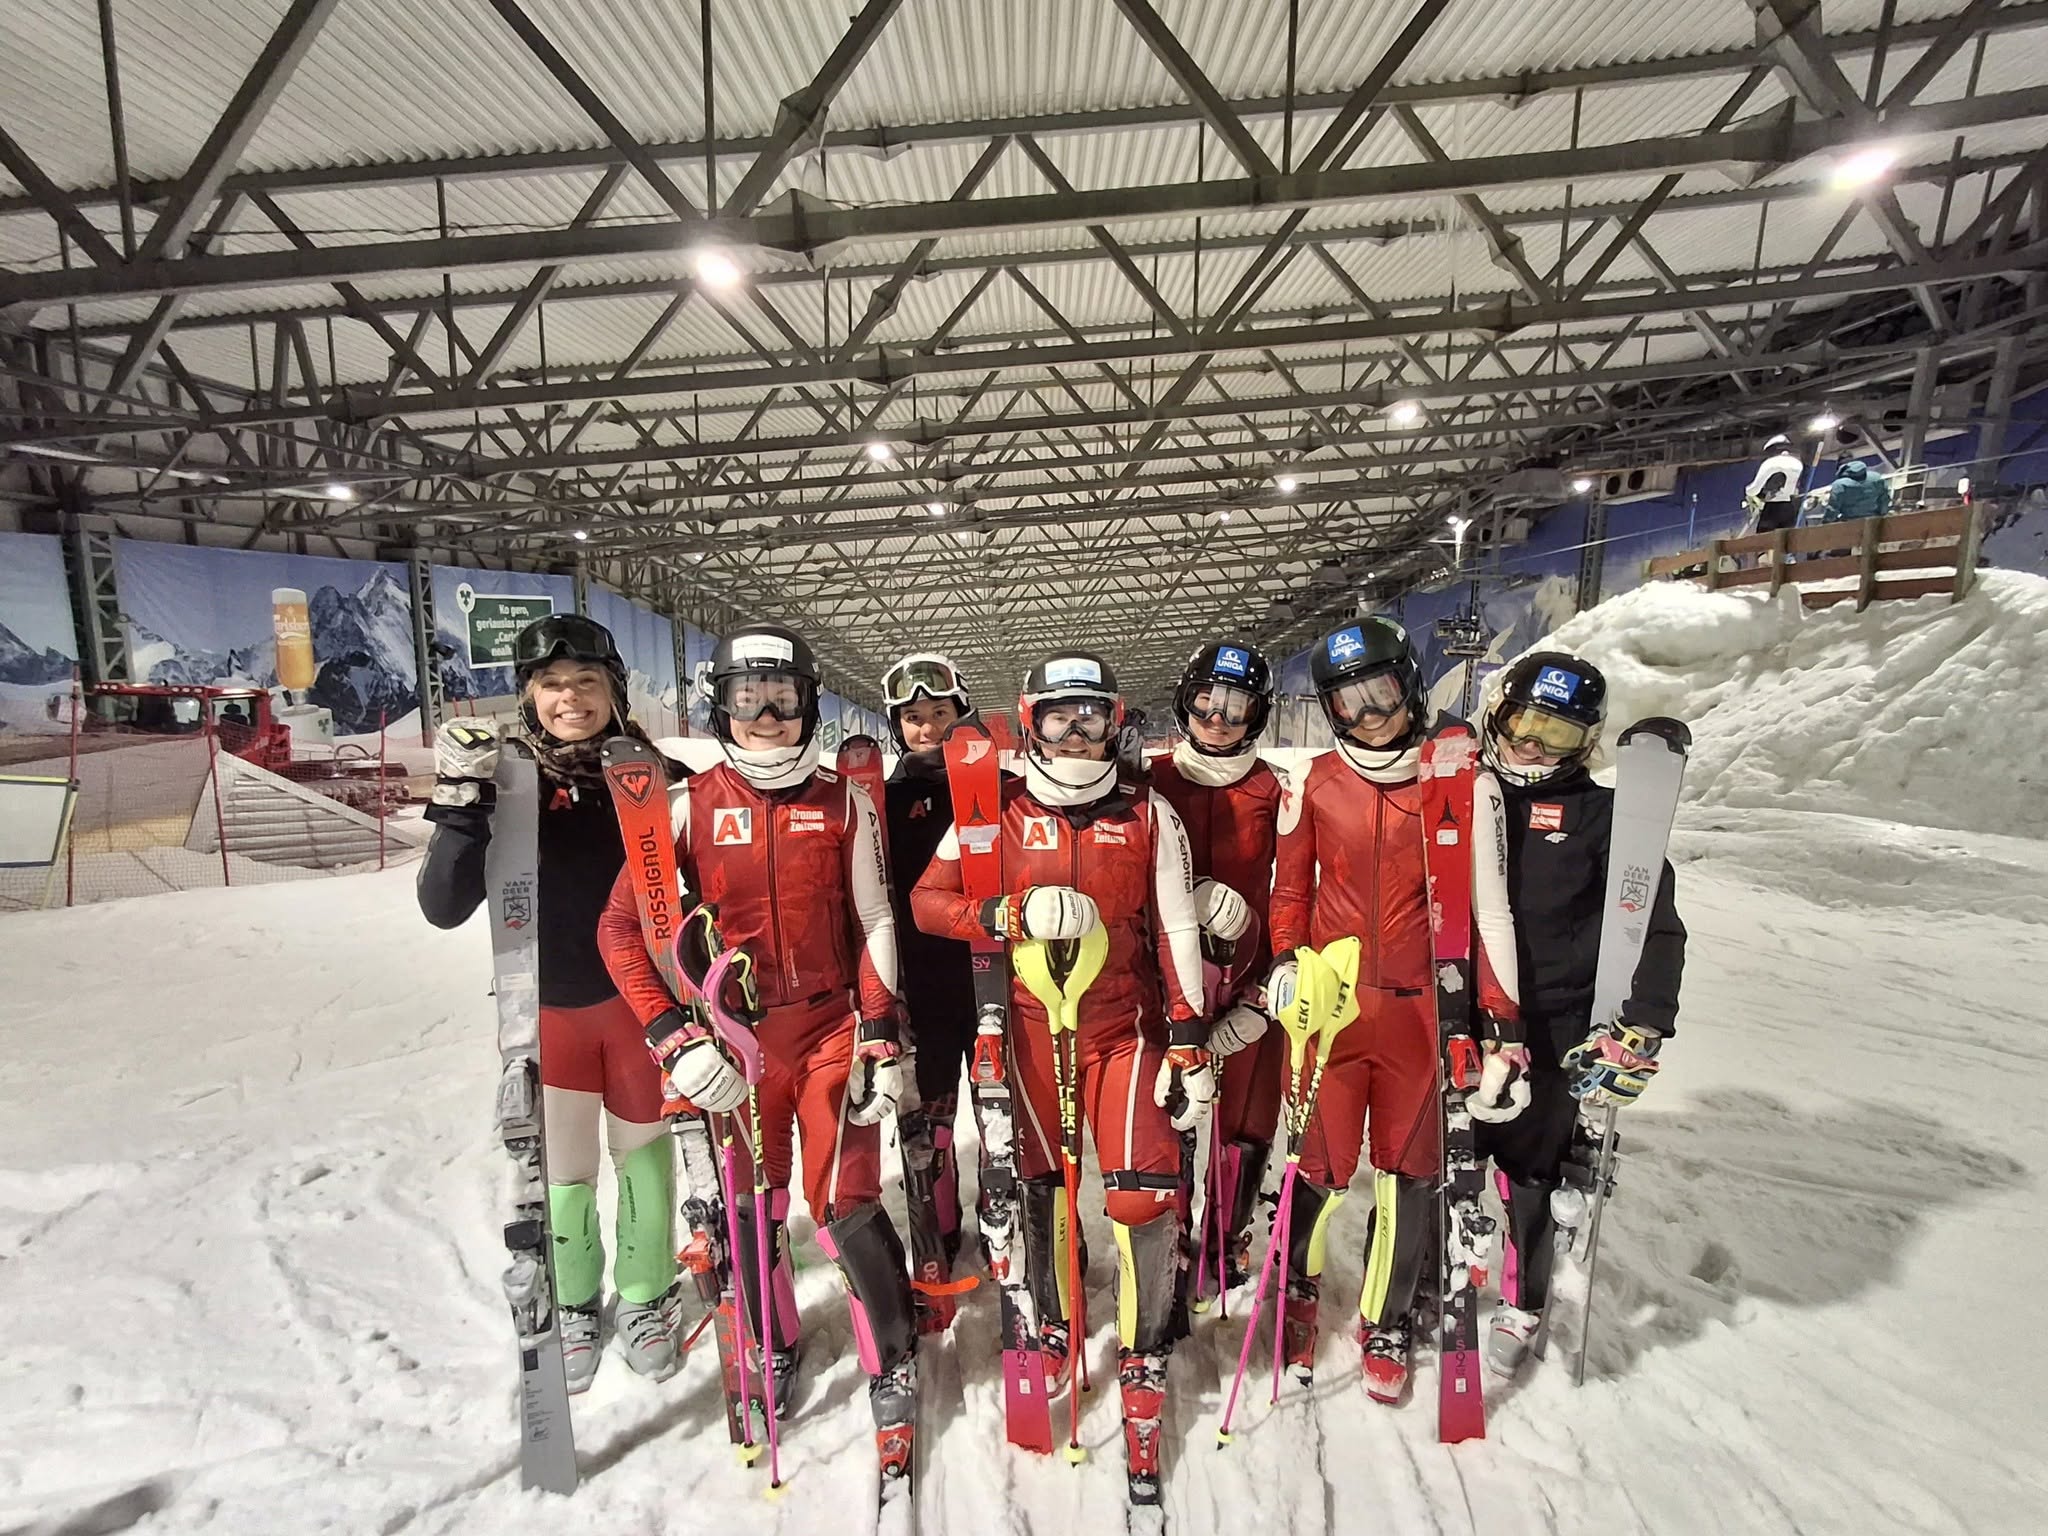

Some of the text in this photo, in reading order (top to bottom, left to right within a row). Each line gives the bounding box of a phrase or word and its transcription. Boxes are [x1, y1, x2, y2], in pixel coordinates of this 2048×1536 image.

[1331, 642, 1362, 657] UNIQA
[1217, 660, 1244, 672] UNIQA
[1535, 682, 1570, 701] UNIQA
[548, 785, 580, 810] A1
[908, 797, 932, 819] A1
[715, 809, 750, 843] A1
[1025, 817, 1056, 847] A1
[1624, 870, 1651, 882] DEER
[1627, 864, 1649, 874] VAN
[639, 826, 672, 941] ROSSIGNOL
[1008, 906, 1019, 938] LEKI
[1331, 980, 1350, 1019] LEKI
[1297, 998, 1310, 1031] LEKI
[1066, 1087, 1076, 1136] LEKI
